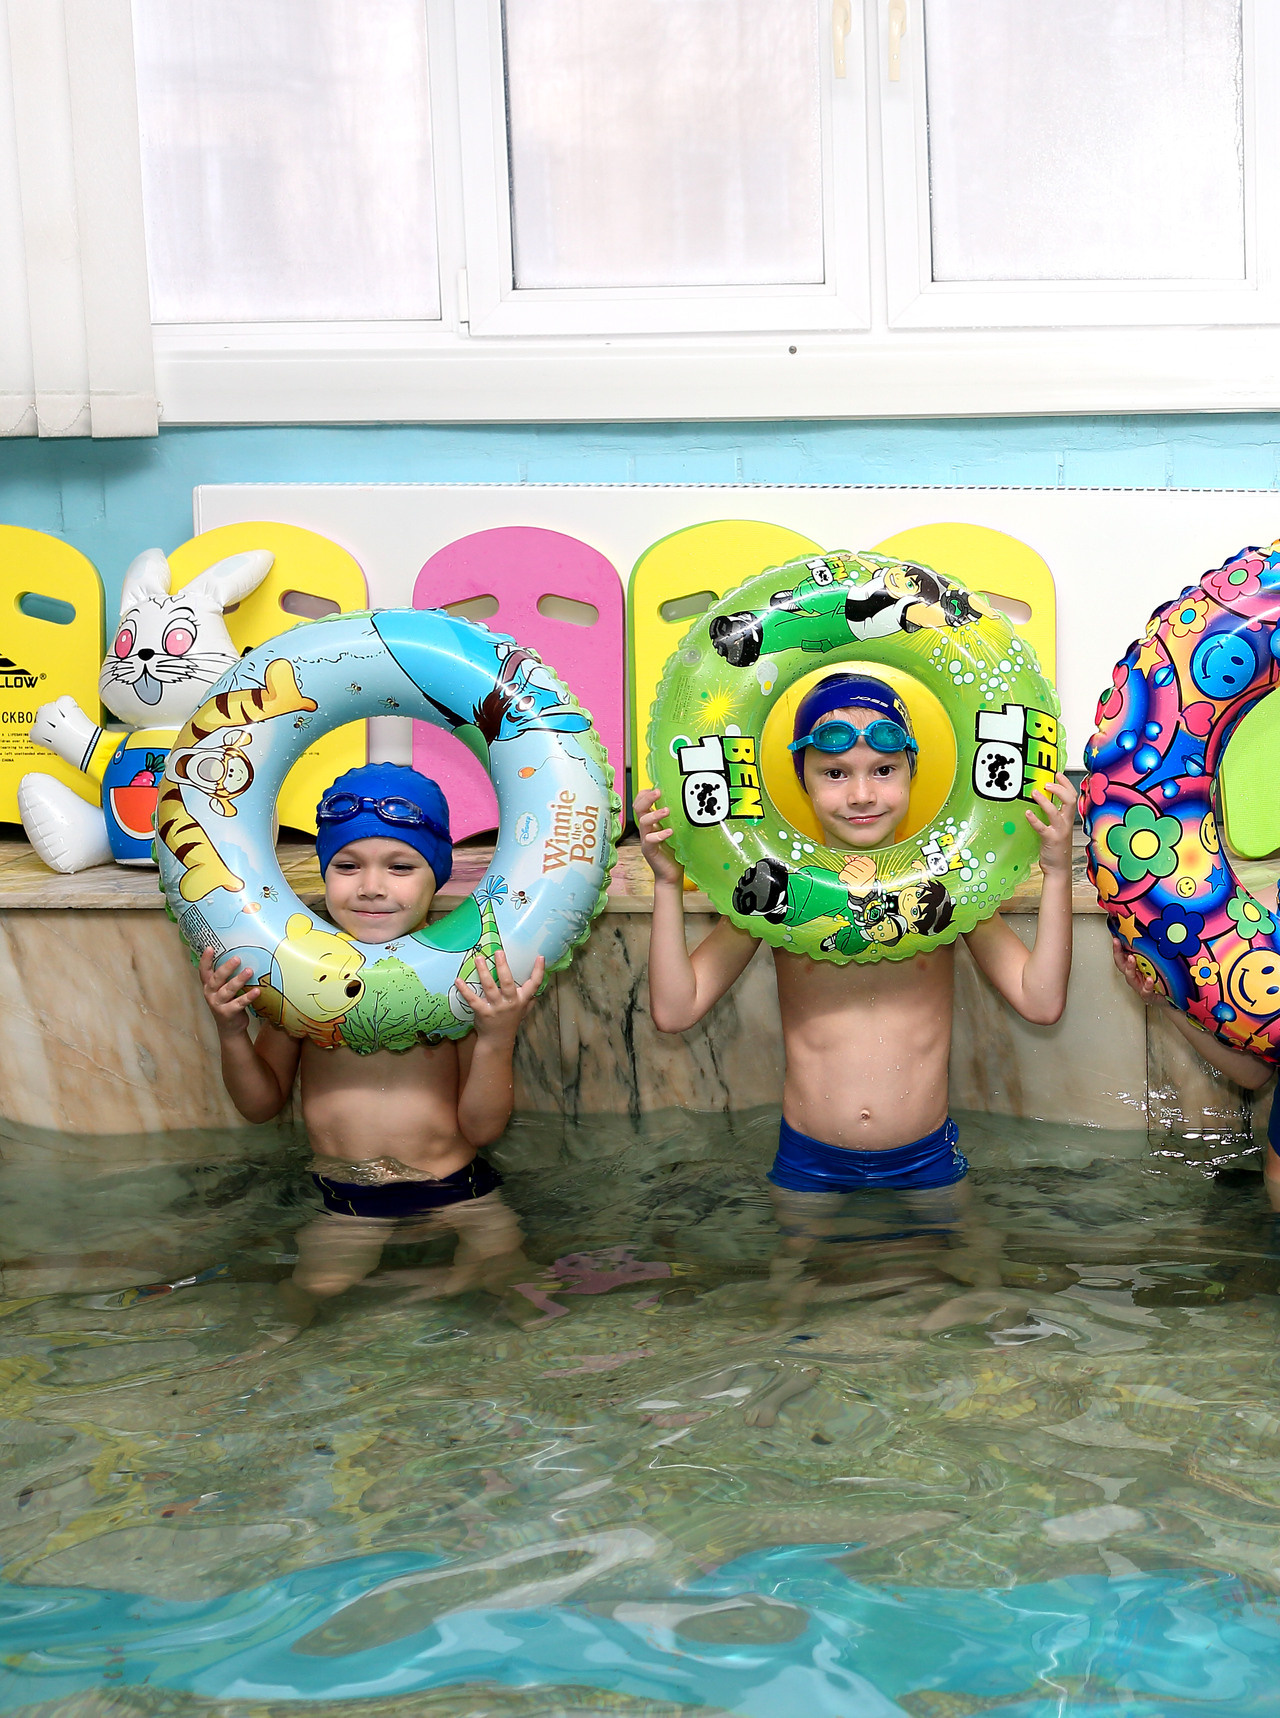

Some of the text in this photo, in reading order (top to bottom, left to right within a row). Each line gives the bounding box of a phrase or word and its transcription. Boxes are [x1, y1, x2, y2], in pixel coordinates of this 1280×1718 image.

[0, 676, 38, 688] LOW
[2, 711, 37, 723] CKBO
[677, 735, 730, 828] 10
[721, 736, 765, 820] BEN
[972, 703, 1025, 802] 10
[520, 816, 534, 841] Disney
[542, 789, 576, 874] Winnie
[569, 805, 599, 865] Pooh
[570, 823, 583, 841] the
